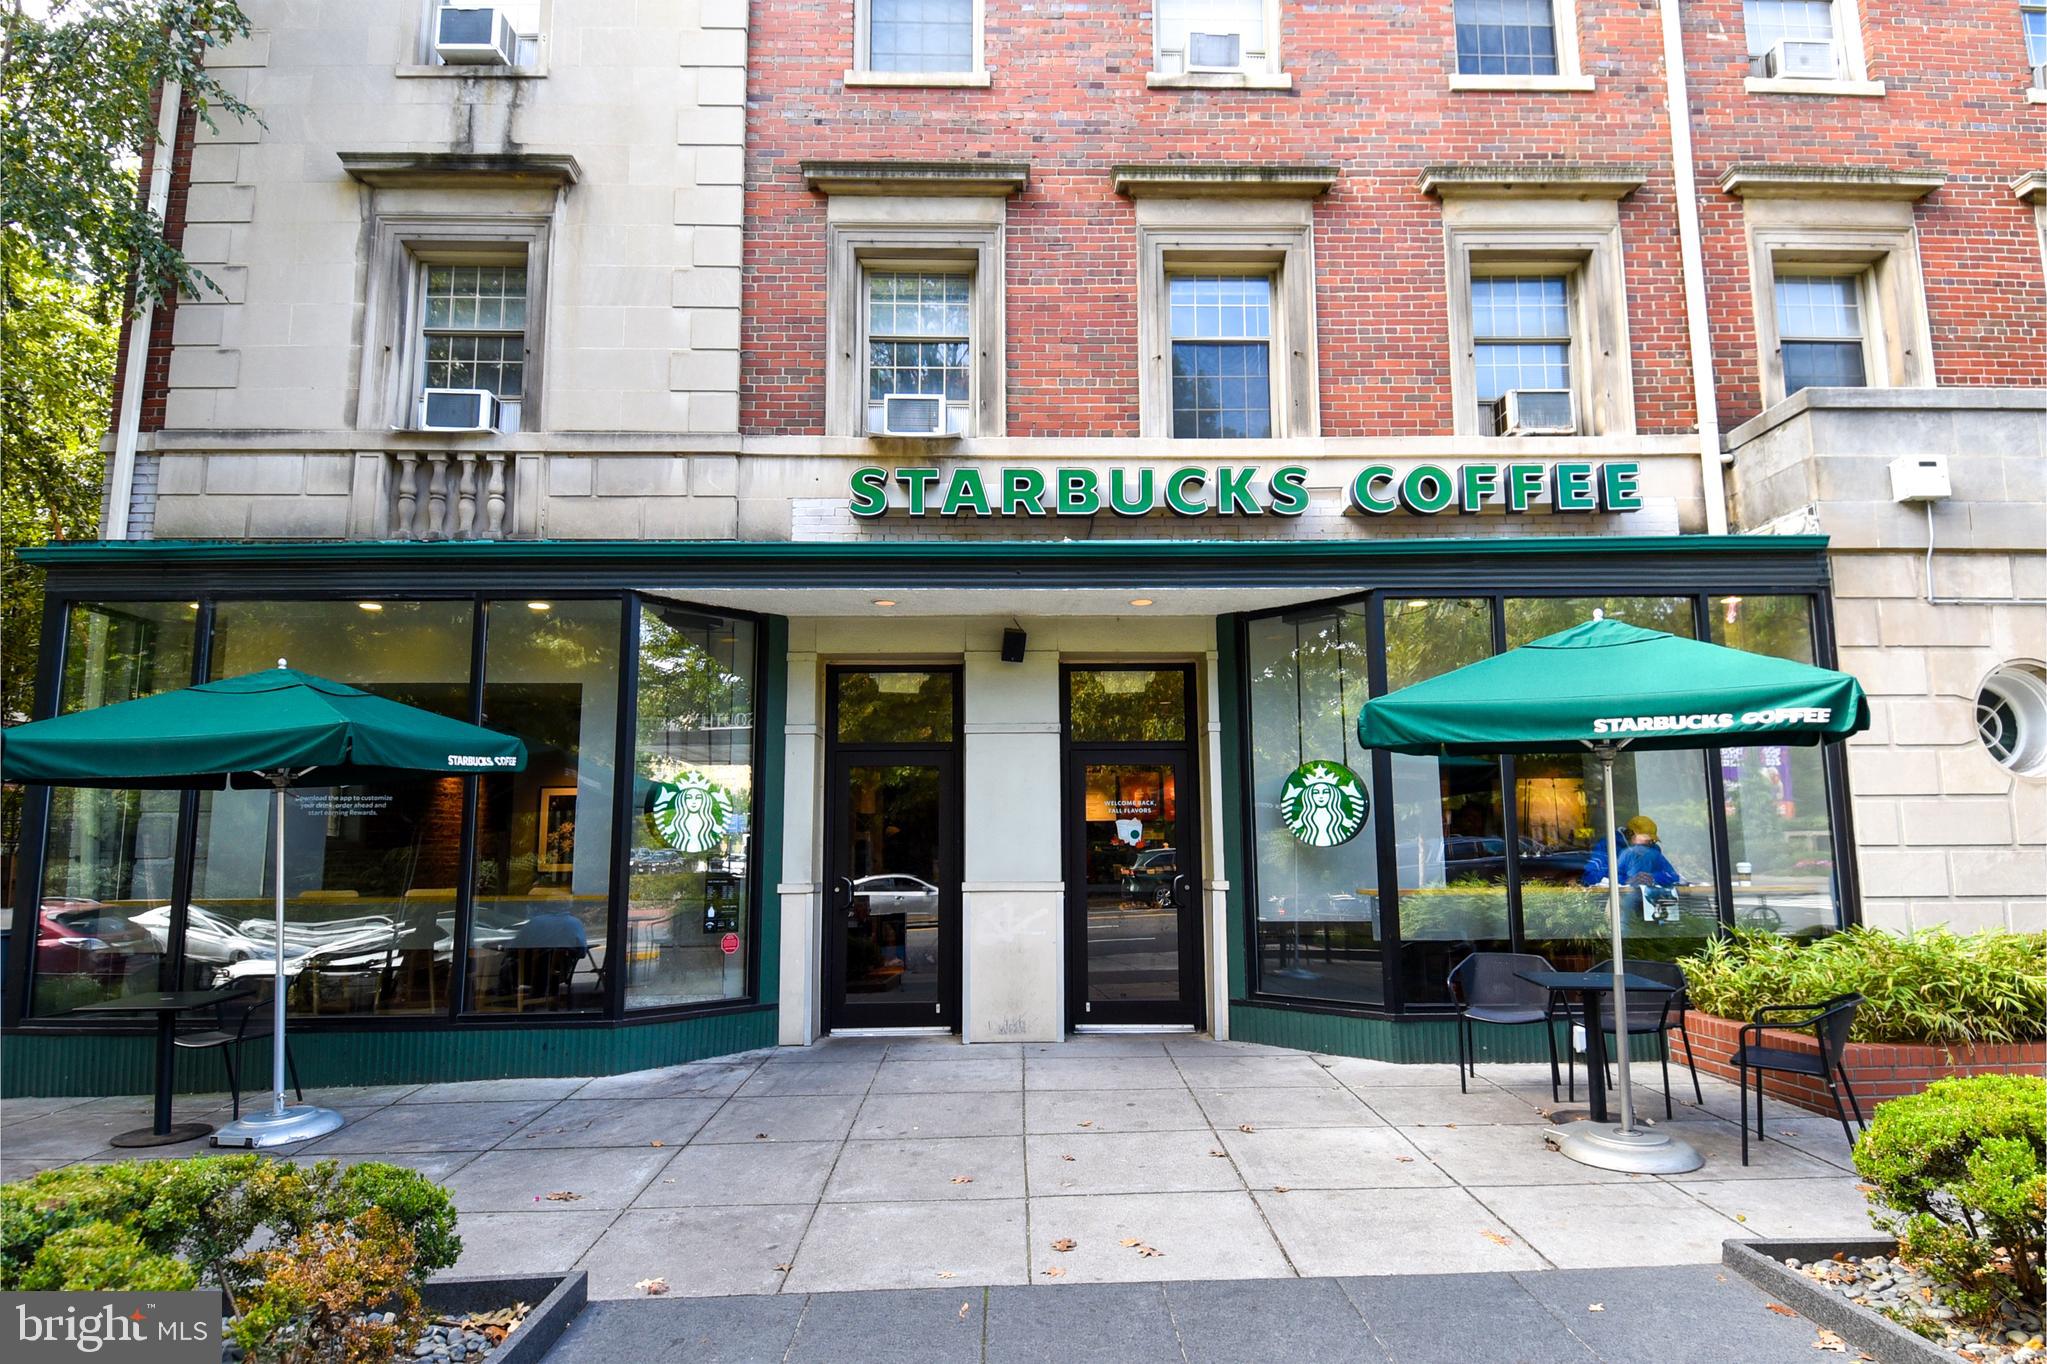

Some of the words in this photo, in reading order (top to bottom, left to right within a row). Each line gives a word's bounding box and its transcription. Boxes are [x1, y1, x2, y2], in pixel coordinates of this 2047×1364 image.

[848, 466, 1311, 519] STARBUCKS
[1350, 461, 1644, 517] COFFEE
[1593, 713, 1733, 733] STARBUCKS
[1741, 707, 1831, 724] COFFEE
[447, 755, 494, 766] STARBUCKS
